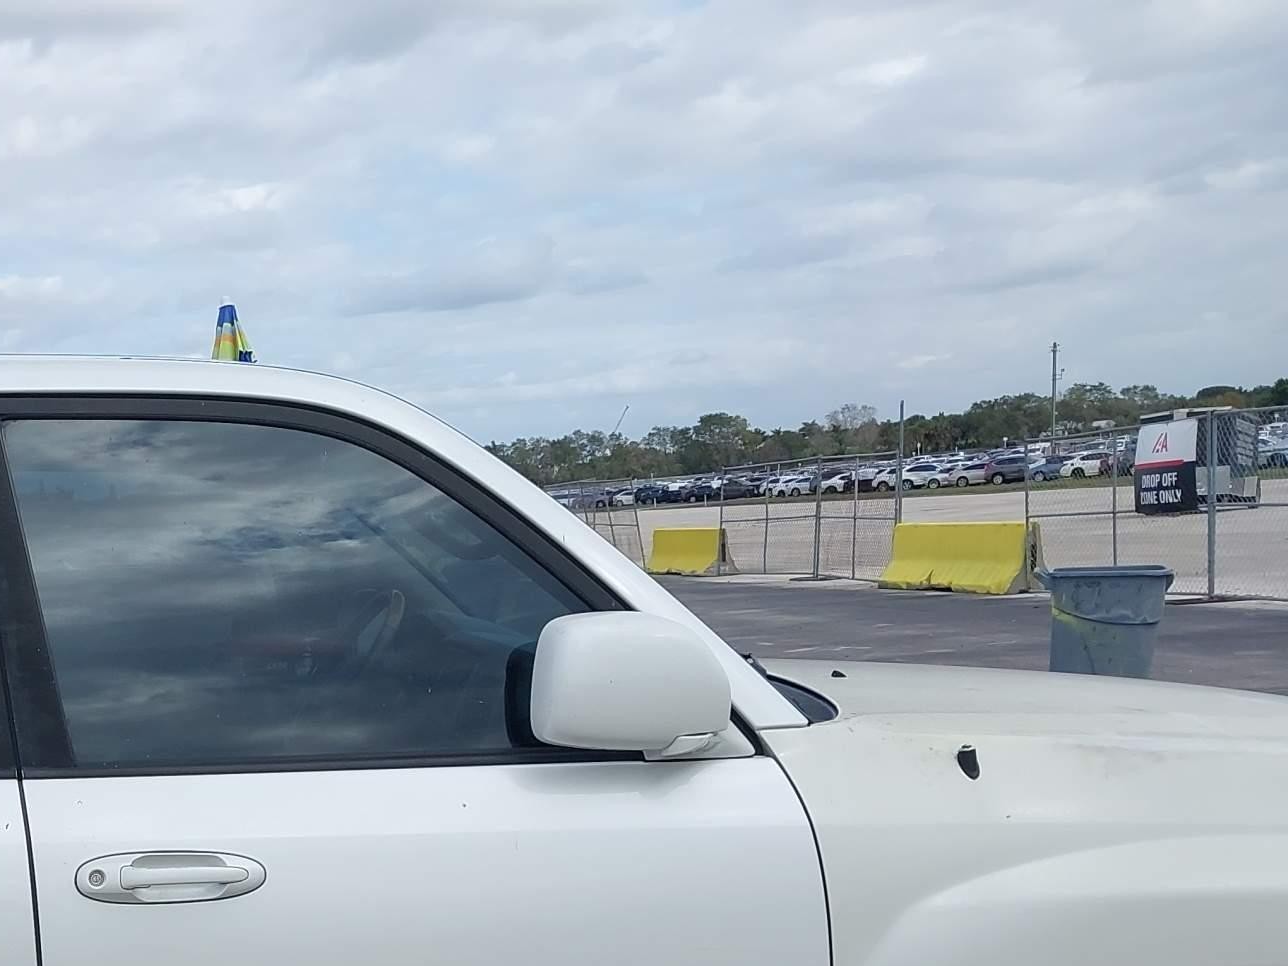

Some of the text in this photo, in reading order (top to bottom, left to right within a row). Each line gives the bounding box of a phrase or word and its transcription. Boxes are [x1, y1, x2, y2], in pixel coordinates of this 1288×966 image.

[1142, 472, 1177, 488] DROP OFF
[1141, 489, 1181, 505] ZONE ONLY
